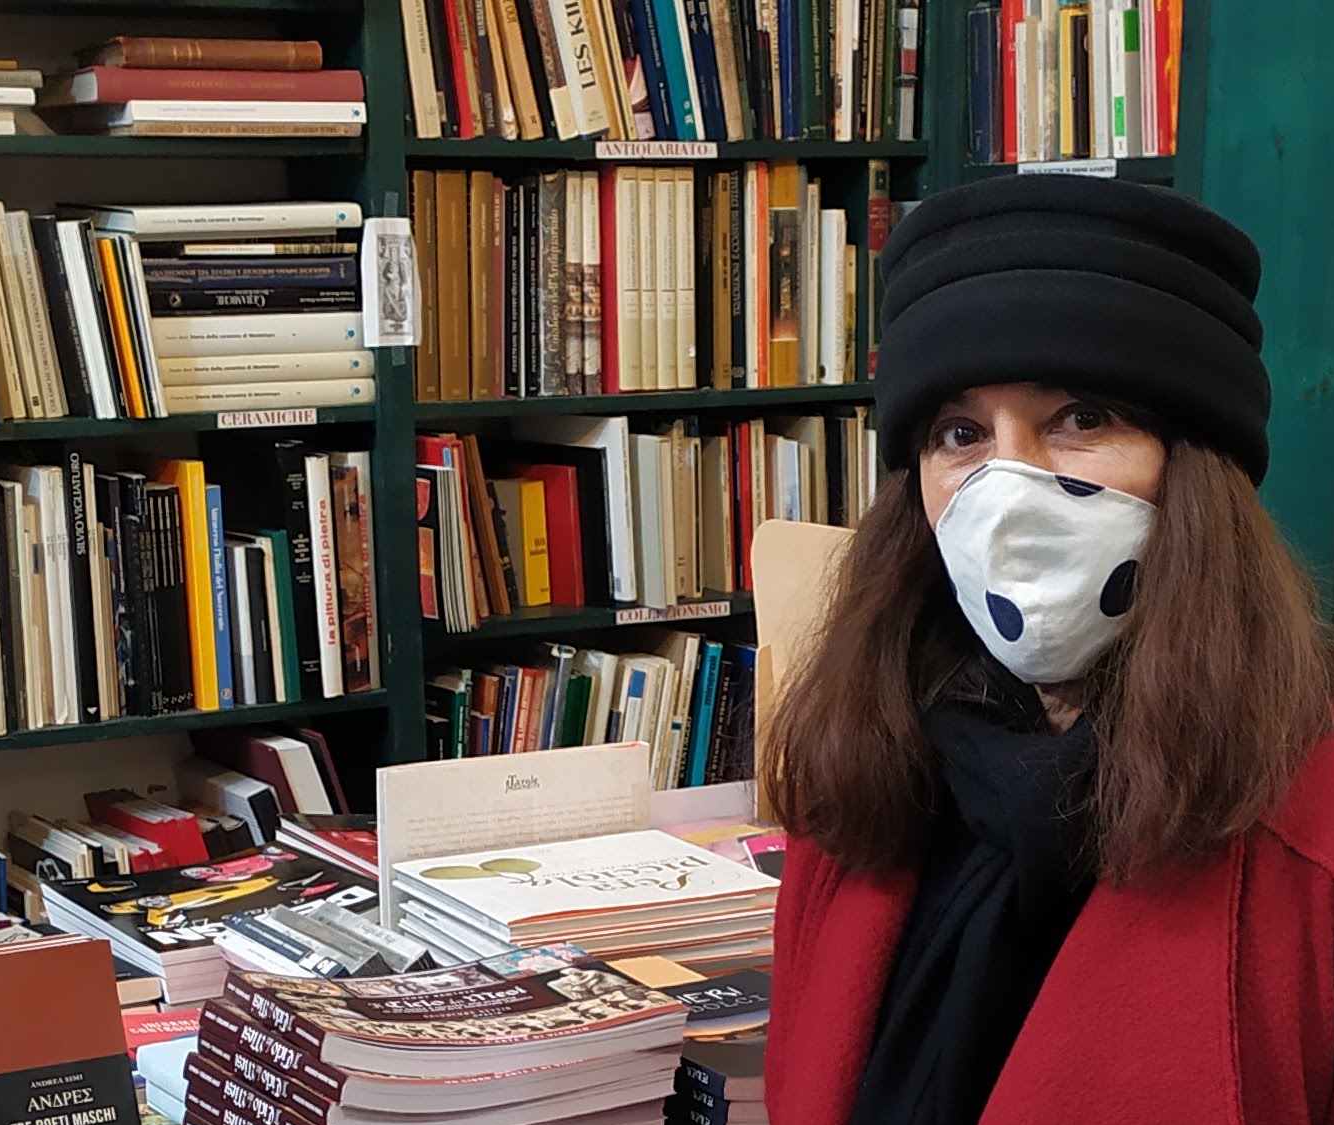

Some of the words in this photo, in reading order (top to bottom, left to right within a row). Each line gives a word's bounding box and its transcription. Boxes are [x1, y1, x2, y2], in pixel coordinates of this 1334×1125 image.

[580, 62, 597, 90] LES
[604, 142, 709, 157] ANTIQUARIATO
[220, 410, 315, 427] CERAMICHE
[69, 452, 83, 520] VIGLIATURO
[74, 520, 87, 556] SILVIO
[317, 498, 331, 550] pietra
[322, 572, 336, 627] pittura
[30, 1075, 63, 1088] ANDREA
[65, 1073, 84, 1083] SIMI
